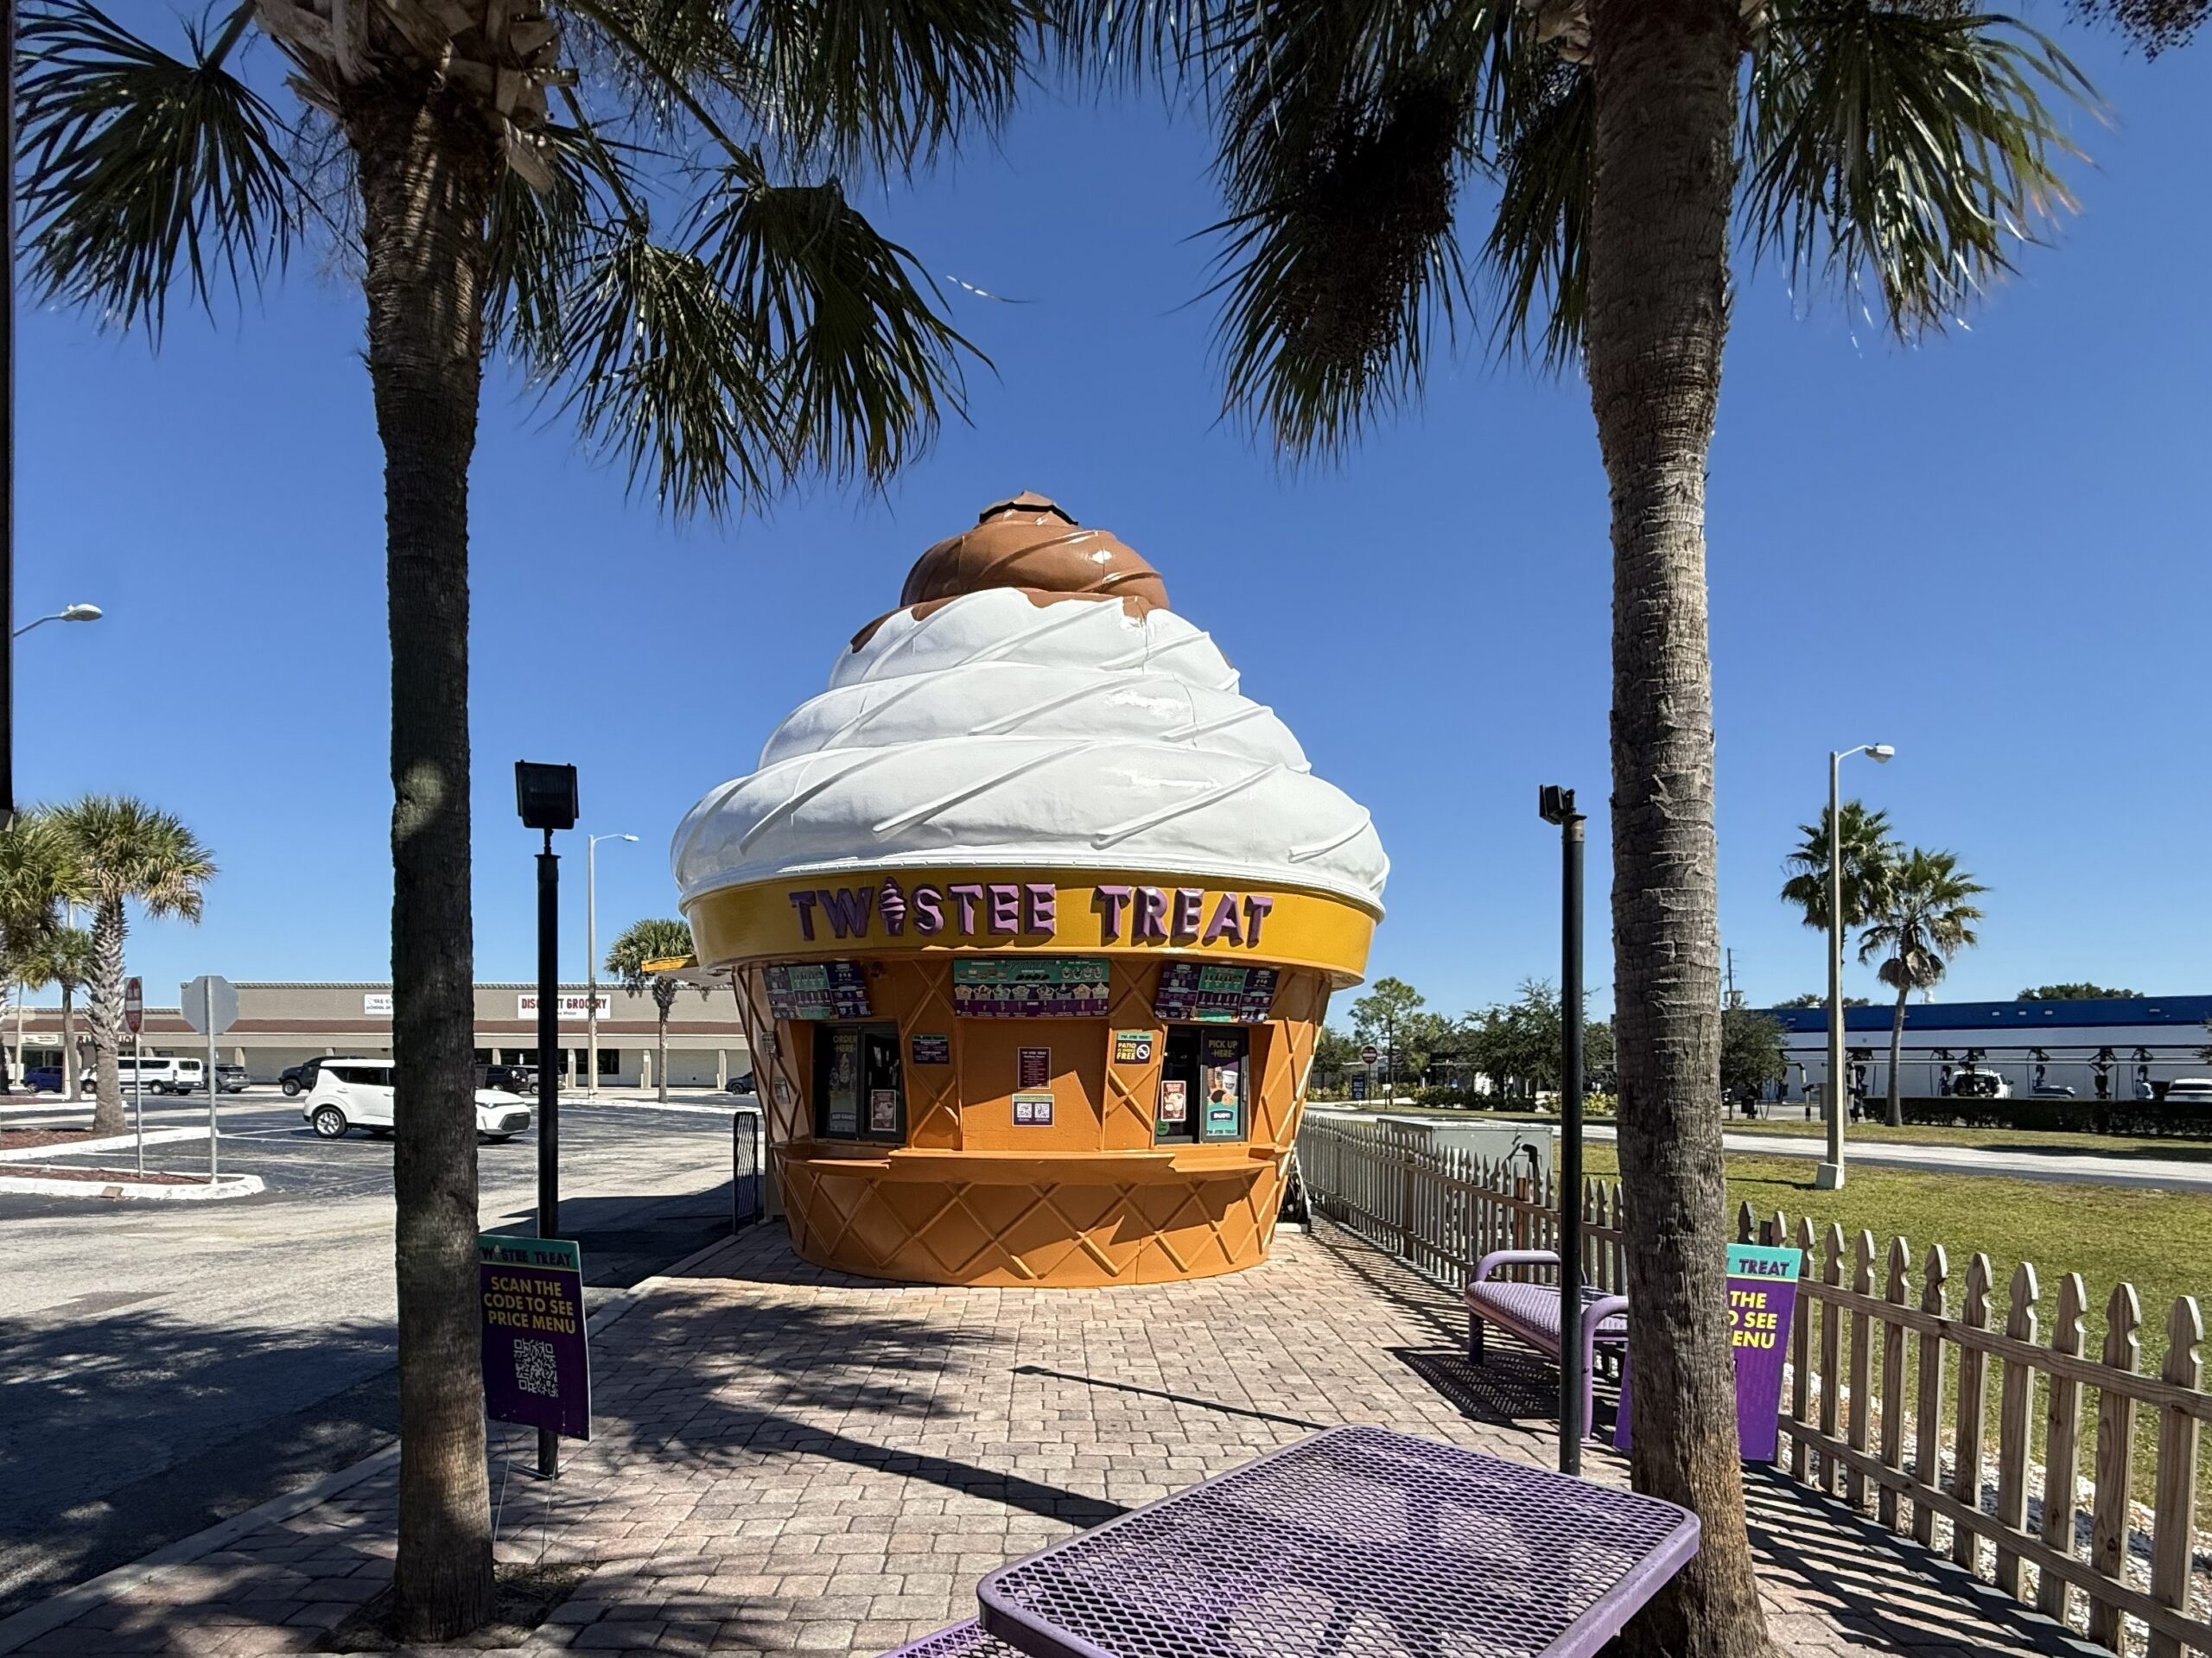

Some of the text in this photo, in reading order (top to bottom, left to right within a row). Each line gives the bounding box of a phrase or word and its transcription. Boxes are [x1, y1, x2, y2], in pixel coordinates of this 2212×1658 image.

[1095, 883, 1274, 949] TREAT
[521, 998, 607, 1010] DIST GROCRY
[1209, 1039, 1237, 1048] PICK UP
[534, 1251, 572, 1267] TREAT
[1738, 1258, 1790, 1276] TREAT
[491, 1276, 563, 1297] SCAN THE
[484, 1293, 575, 1317] CODE TO SEE
[1730, 1290, 1768, 1309] THE
[487, 1310, 576, 1335] PRICE MENU
[1744, 1311, 1778, 1330] SEE
[1732, 1330, 1776, 1350] ENU
